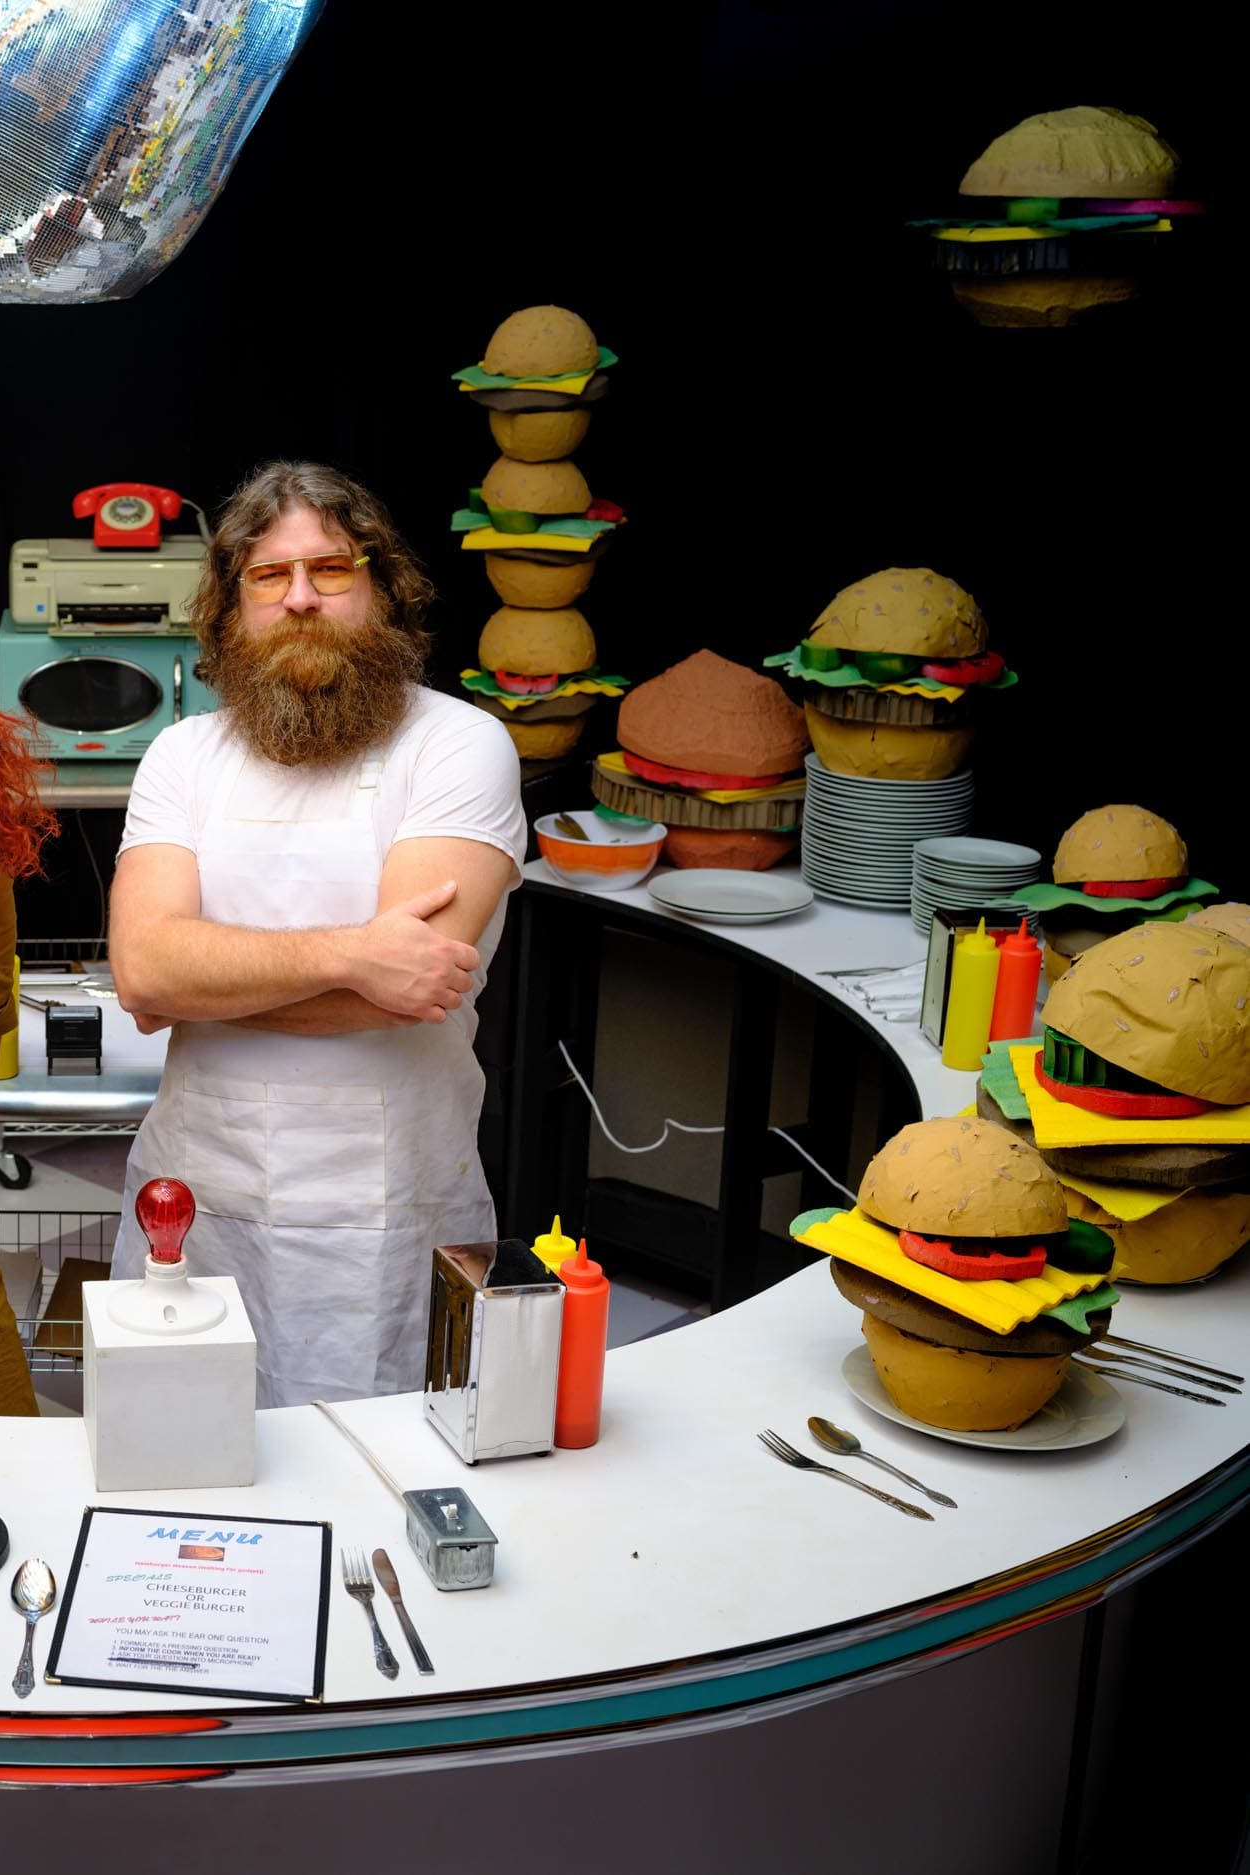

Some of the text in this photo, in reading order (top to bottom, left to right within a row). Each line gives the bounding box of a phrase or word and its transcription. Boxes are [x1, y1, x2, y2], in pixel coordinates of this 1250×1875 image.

[147, 1527, 263, 1545] MENU
[105, 1573, 173, 1582] SPECIALS
[146, 1583, 247, 1597] CHEESEBURGER
[186, 1594, 205, 1602] OR
[143, 1599, 246, 1613] VEGGIE BURGER
[127, 1616, 150, 1624] YOU
[152, 1614, 181, 1622] WAIT
[135, 1628, 151, 1636] MAY
[172, 1631, 187, 1639] THE
[189, 1632, 205, 1640] EAR
[207, 1634, 225, 1642] ONE
[227, 1635, 270, 1645] QUESTION
[120, 1640, 159, 1648] FORMULATE
[167, 1643, 202, 1651] PRESSING
[203, 1646, 238, 1654] QUESTION
[208, 1657, 253, 1666] MICROPHONE
